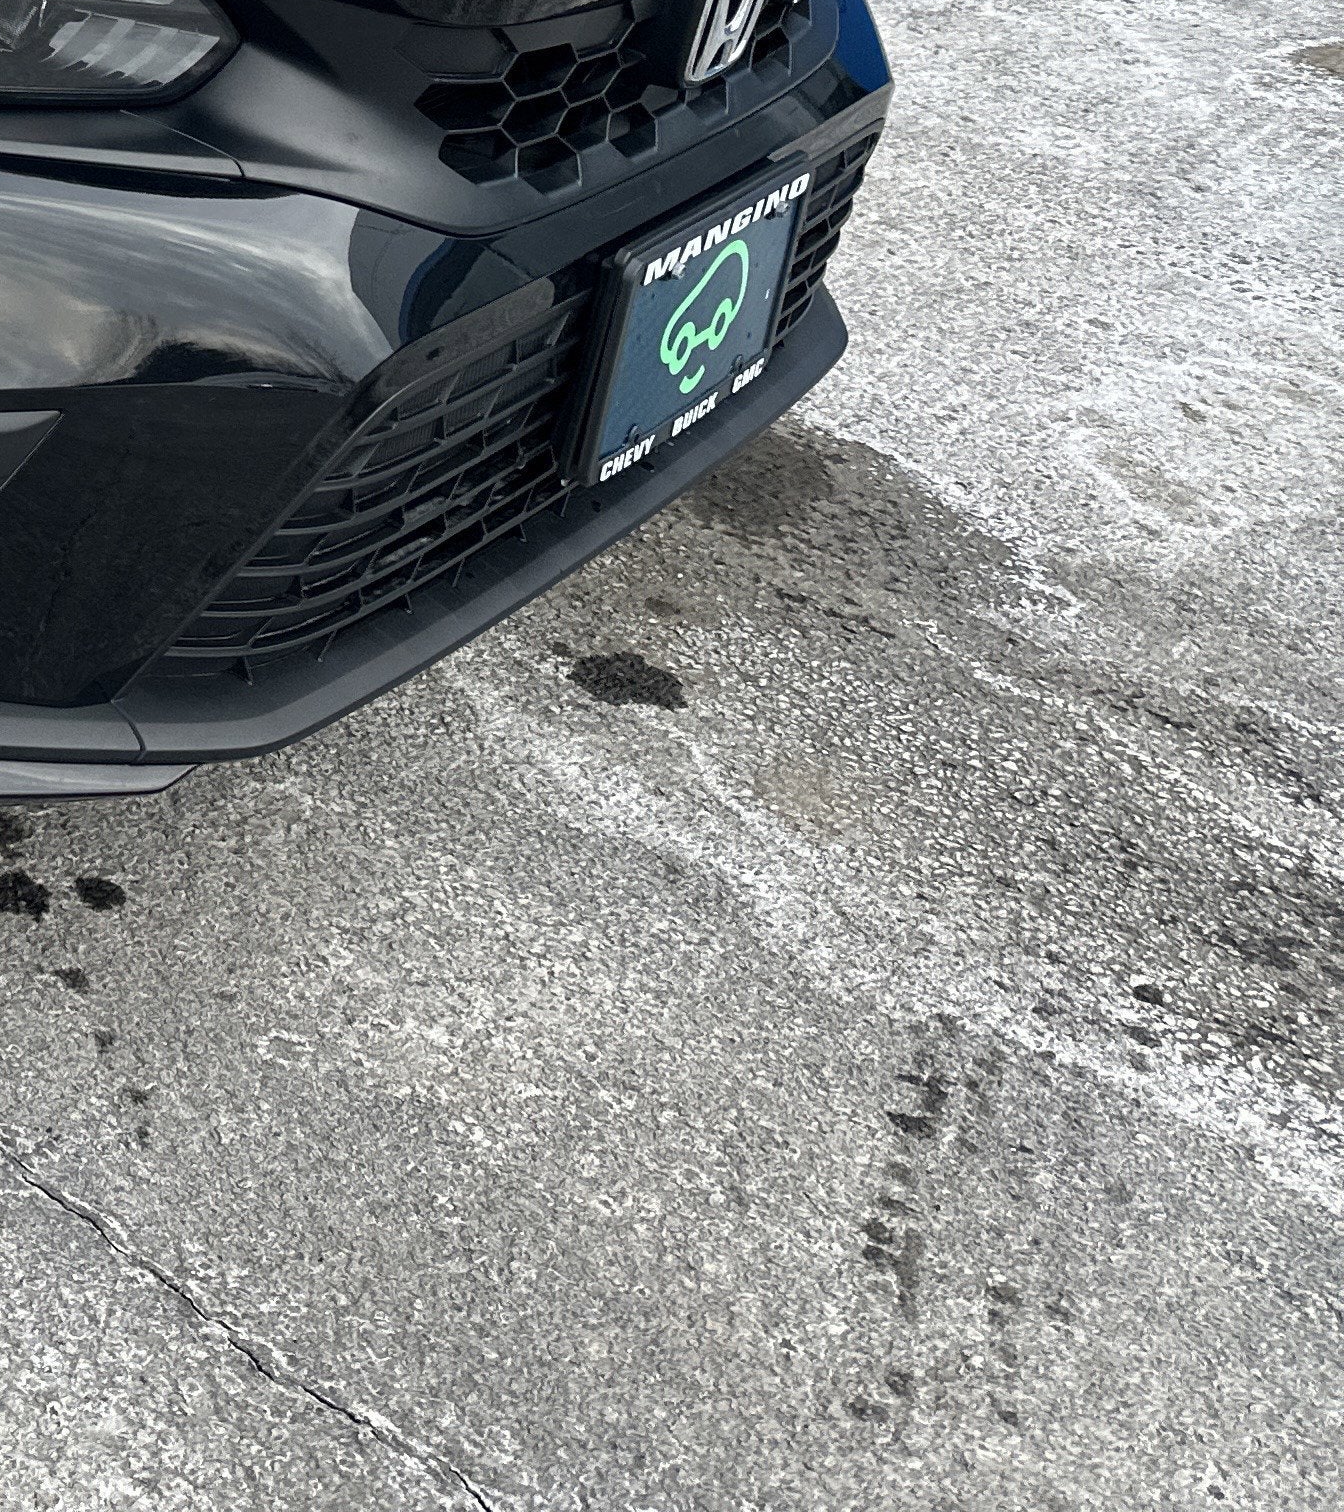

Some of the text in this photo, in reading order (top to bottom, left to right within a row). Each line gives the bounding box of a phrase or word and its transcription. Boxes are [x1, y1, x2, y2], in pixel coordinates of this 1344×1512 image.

[643, 172, 811, 286] MANGINO
[599, 357, 765, 482] CHEVY BUICK GMC
